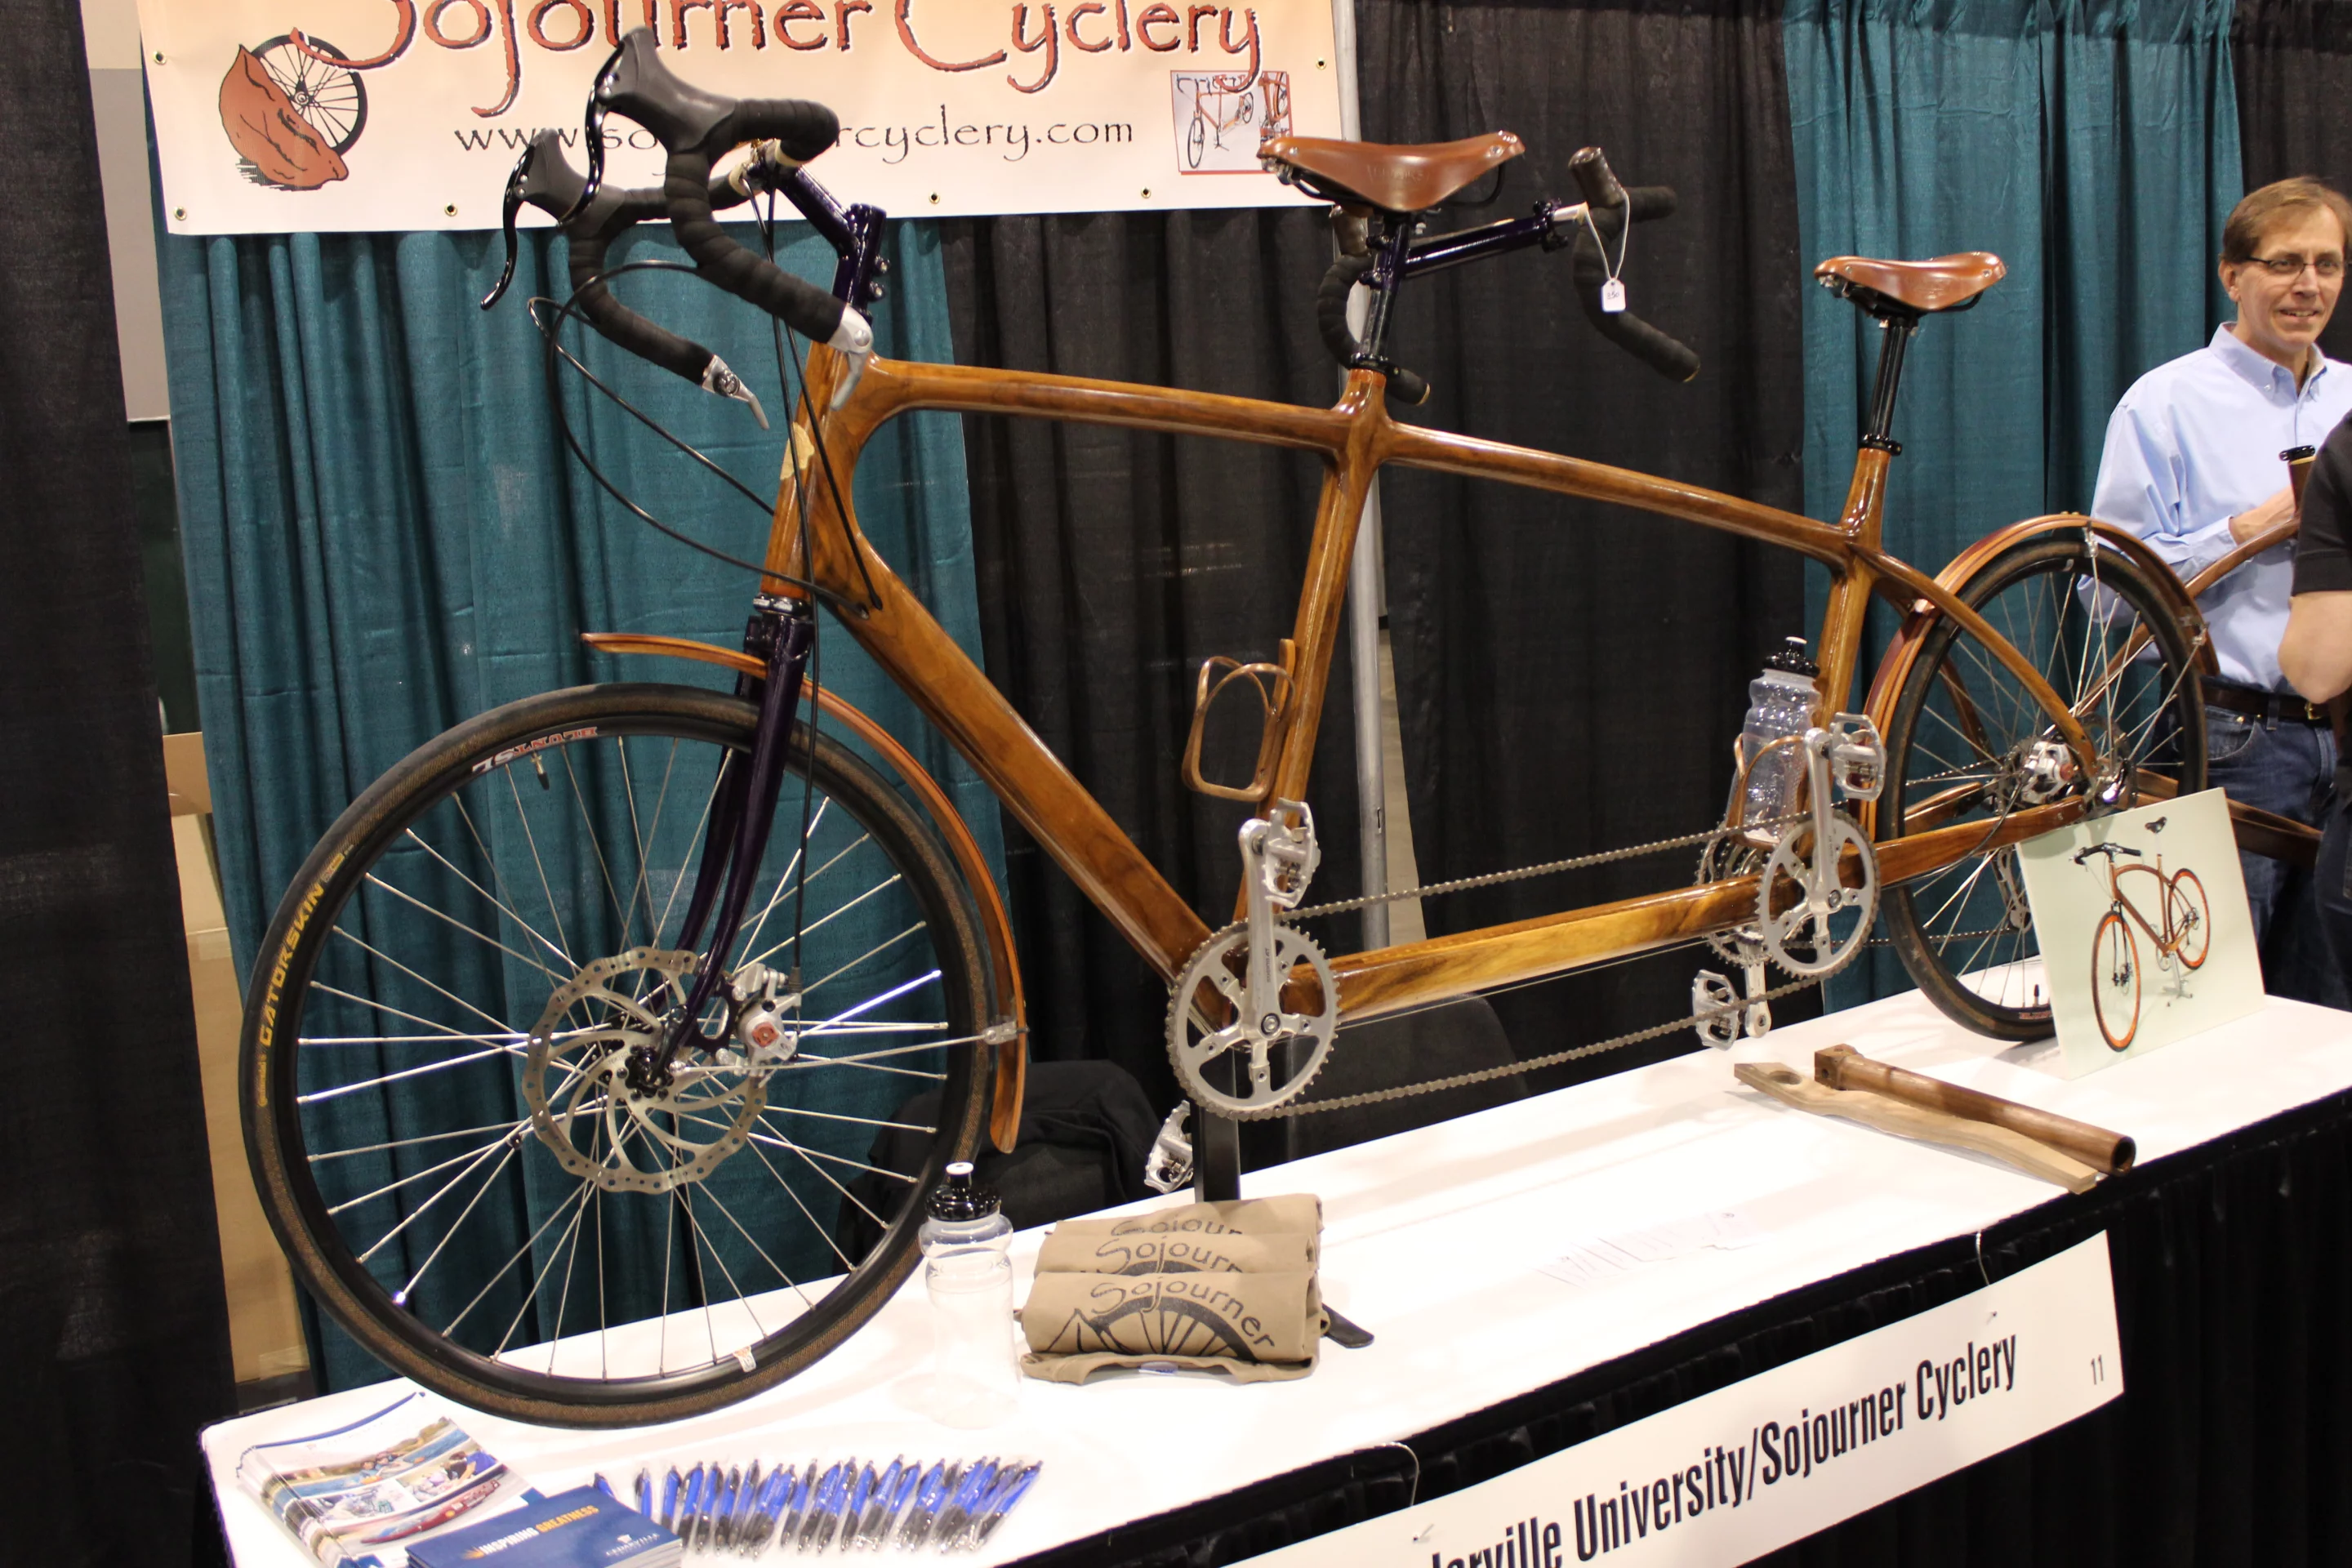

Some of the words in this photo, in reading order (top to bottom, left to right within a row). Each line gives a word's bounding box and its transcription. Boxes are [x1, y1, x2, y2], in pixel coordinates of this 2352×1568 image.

[258, 882, 325, 1048] GATORSKIN
[1090, 1276, 1276, 1348] Sojourner
[2090, 1354, 2105, 1385] 11
[1573, 1380, 1907, 1562] University/Sojourner
[1916, 1334, 2017, 1421] Cyclery
[536, 1505, 599, 1533] GREATNESS
